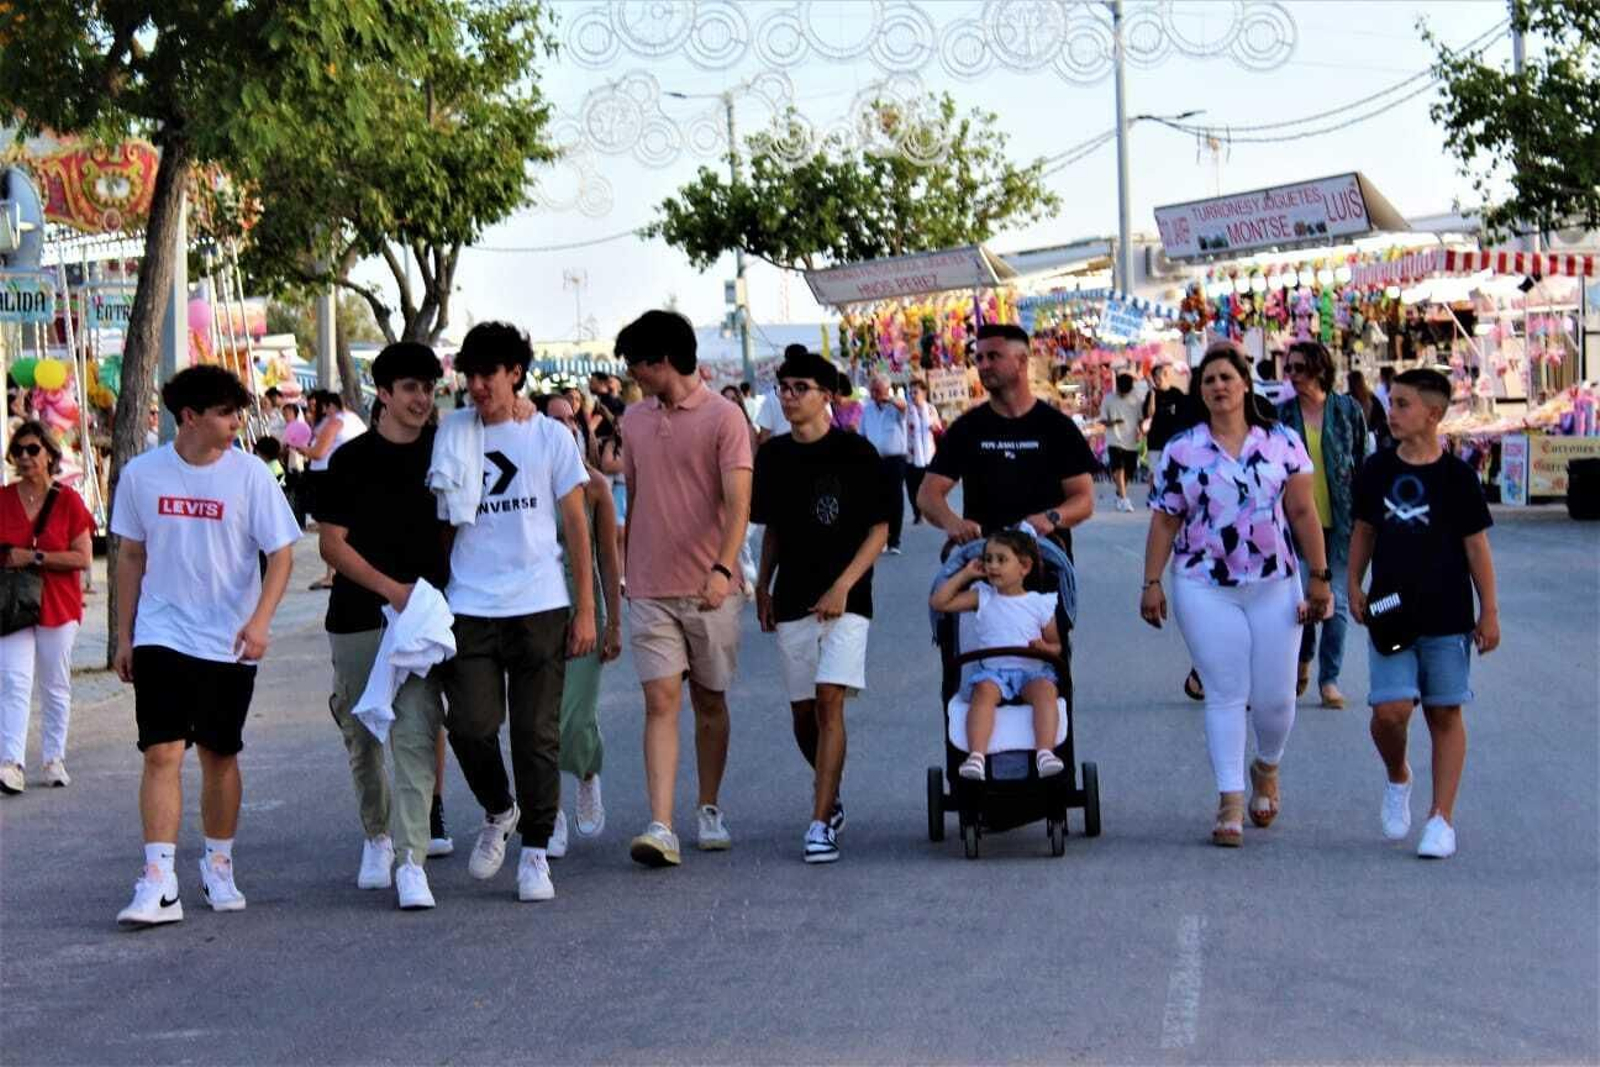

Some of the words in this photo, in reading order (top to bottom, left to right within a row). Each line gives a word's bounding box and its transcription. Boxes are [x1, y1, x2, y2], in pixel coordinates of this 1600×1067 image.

[1322, 187, 1364, 222] LUIS
[1226, 215, 1292, 246] MONTSE
[163, 499, 218, 517] LEVI'S
[476, 497, 537, 515] NVERSE
[1369, 593, 1401, 616] PUMA
